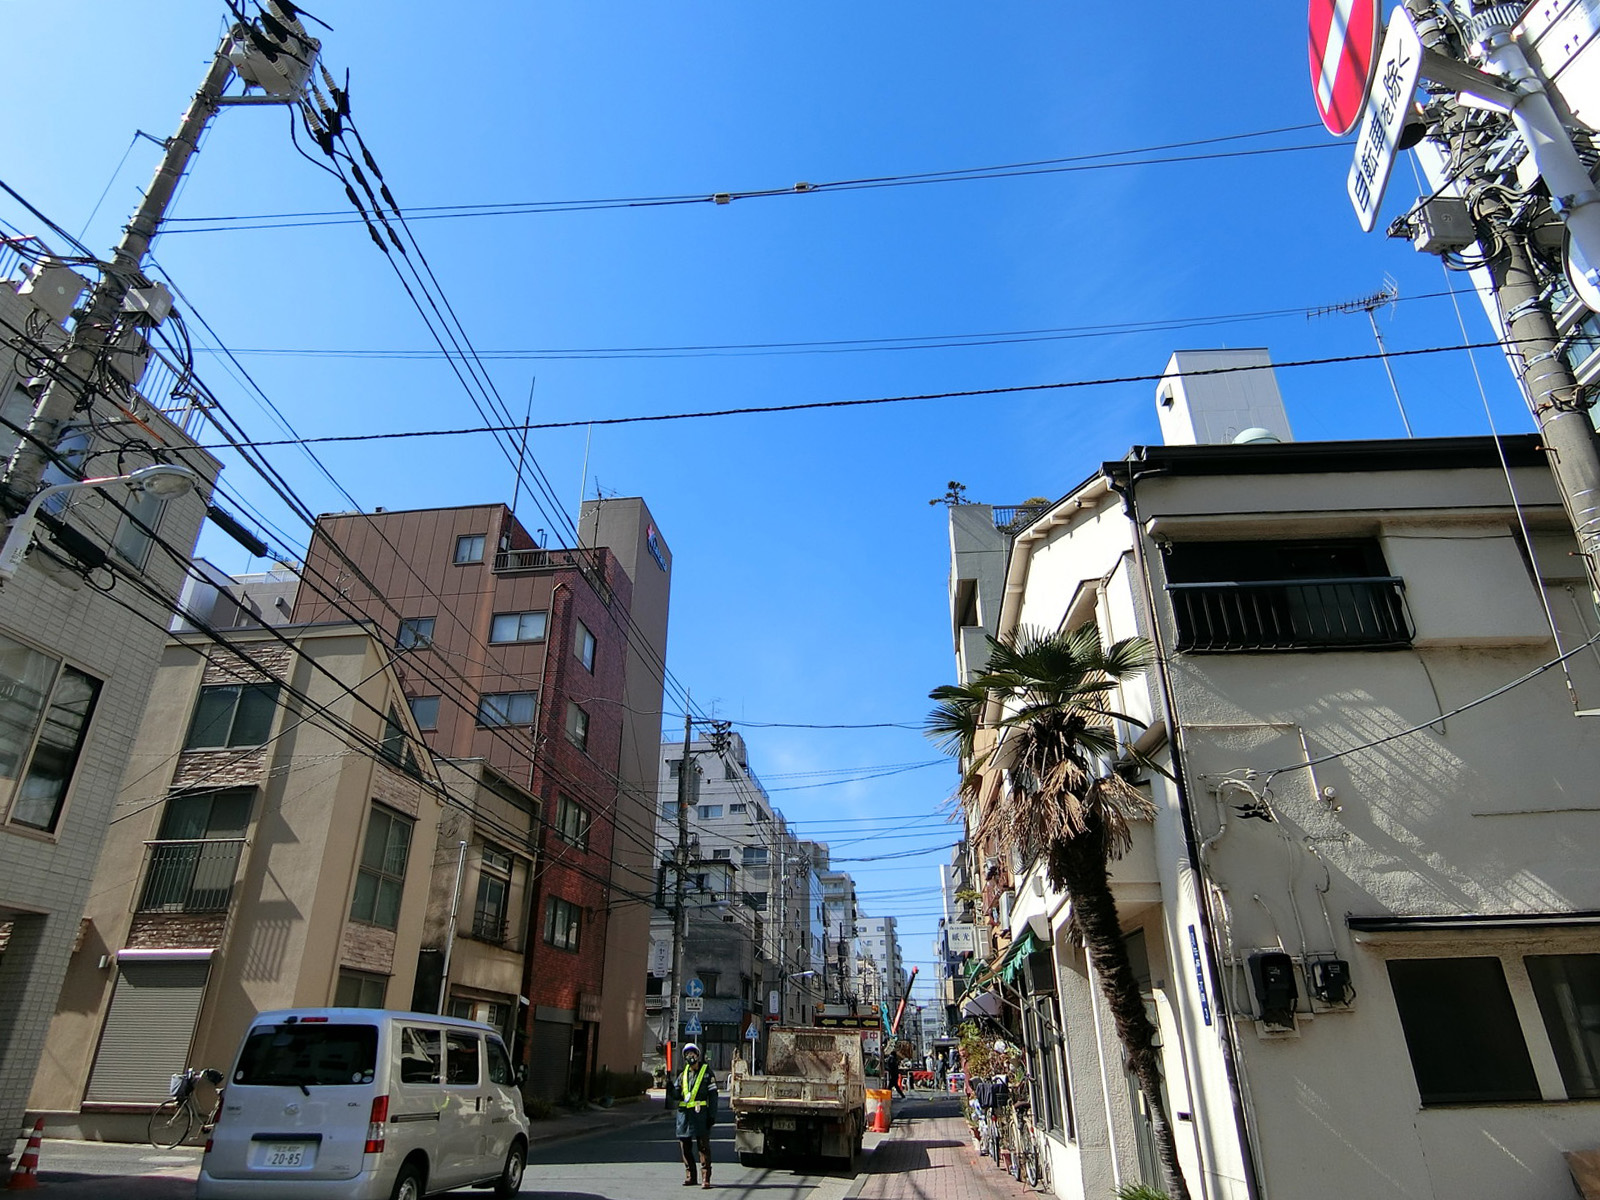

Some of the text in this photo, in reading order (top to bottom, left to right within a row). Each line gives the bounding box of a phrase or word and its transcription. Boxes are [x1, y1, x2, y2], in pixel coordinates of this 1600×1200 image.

[1355, 38, 1411, 214] 自転車を除く
[271, 1153, 301, 1165] 20-85
